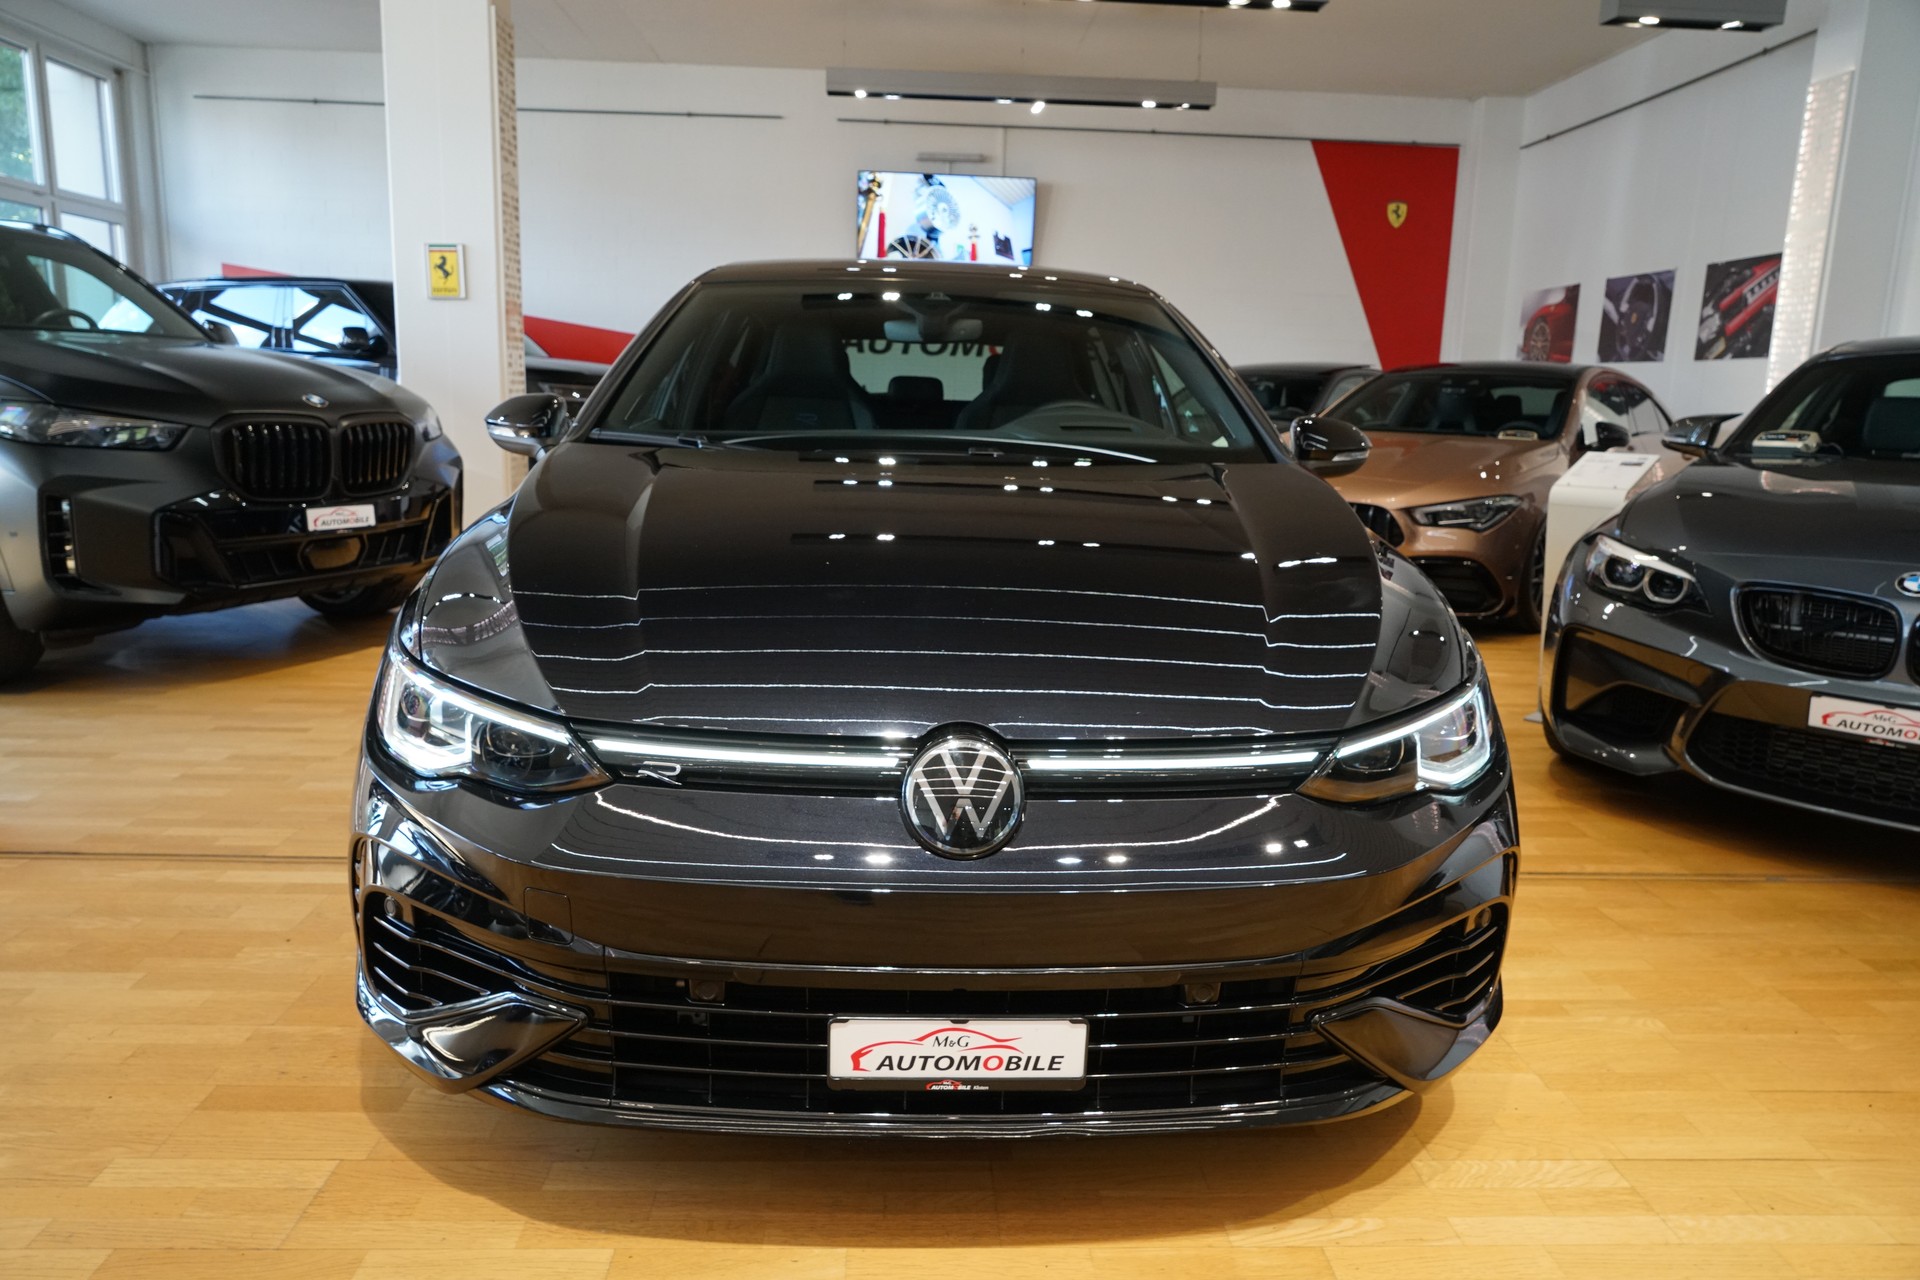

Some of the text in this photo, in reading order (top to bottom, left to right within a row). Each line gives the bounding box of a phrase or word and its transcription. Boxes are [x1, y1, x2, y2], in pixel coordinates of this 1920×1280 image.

[321, 516, 370, 527] AUTOMOBILE
[1873, 713, 1897, 724] M&G
[1836, 719, 1920, 740] AUTOMO
[638, 760, 683, 786] R
[932, 1035, 971, 1048] M&G
[875, 1055, 1065, 1072] AUTOMOBILE
